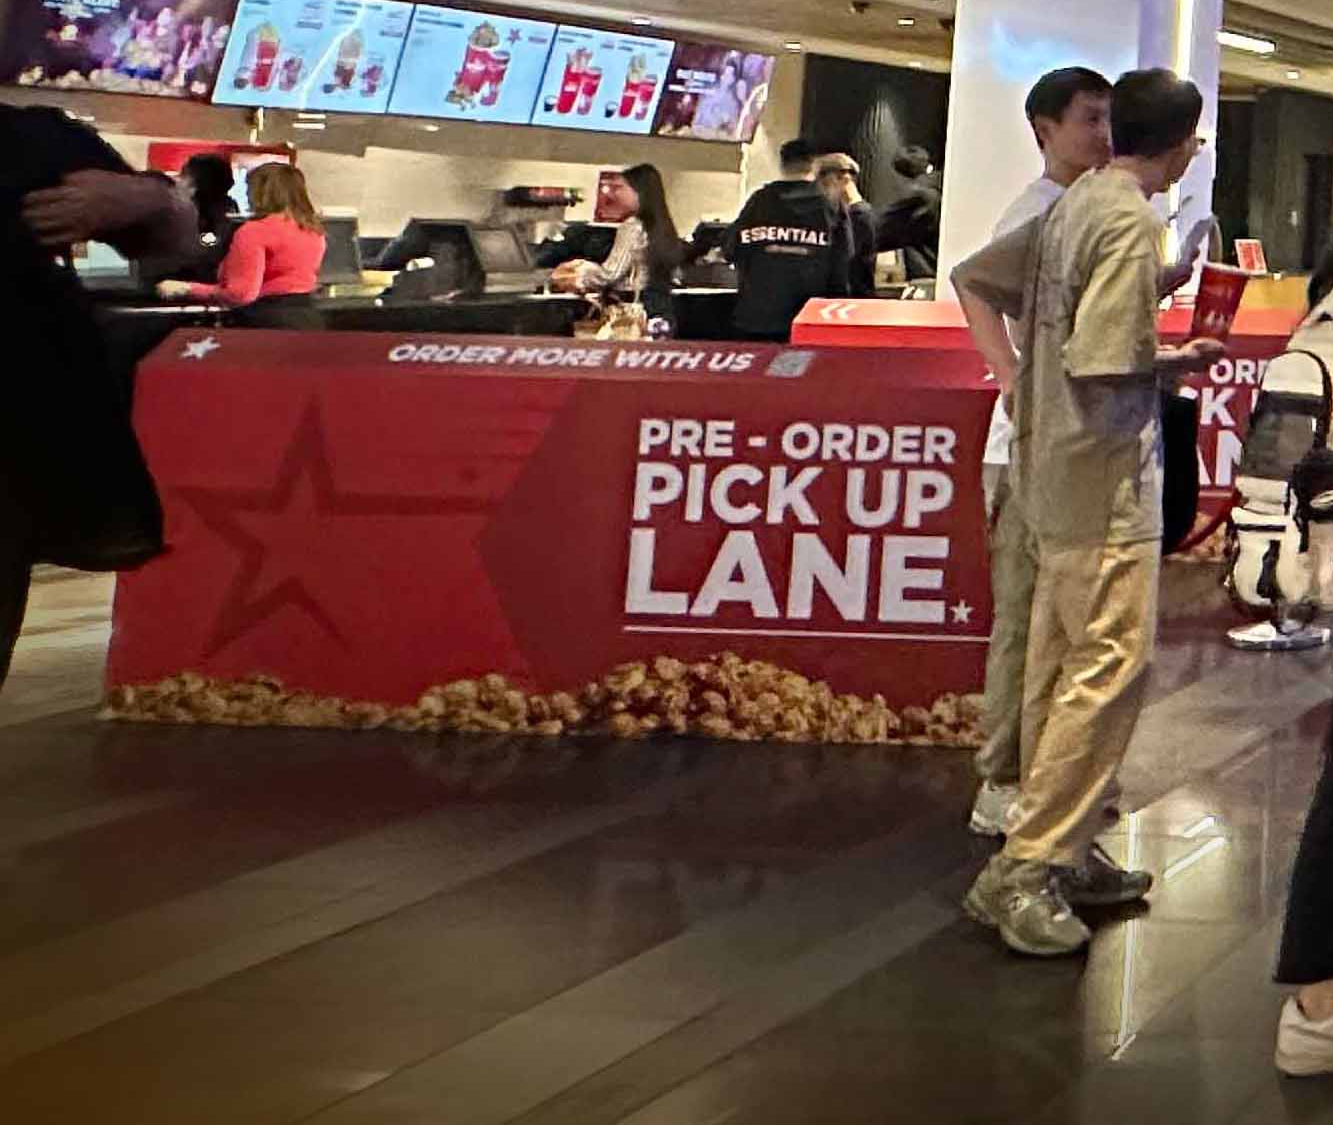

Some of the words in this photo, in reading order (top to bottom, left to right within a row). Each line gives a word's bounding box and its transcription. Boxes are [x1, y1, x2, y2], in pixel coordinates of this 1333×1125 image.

[388, 344, 504, 365] ORDER
[506, 346, 608, 367] MORE
[614, 349, 703, 370] WITH
[706, 352, 756, 372] US
[1180, 386, 1236, 426] K
[639, 418, 735, 457] PRE
[781, 422, 957, 464] ORDER
[632, 461, 824, 527] PICK
[845, 467, 955, 529] UP
[624, 527, 950, 624] LANE
